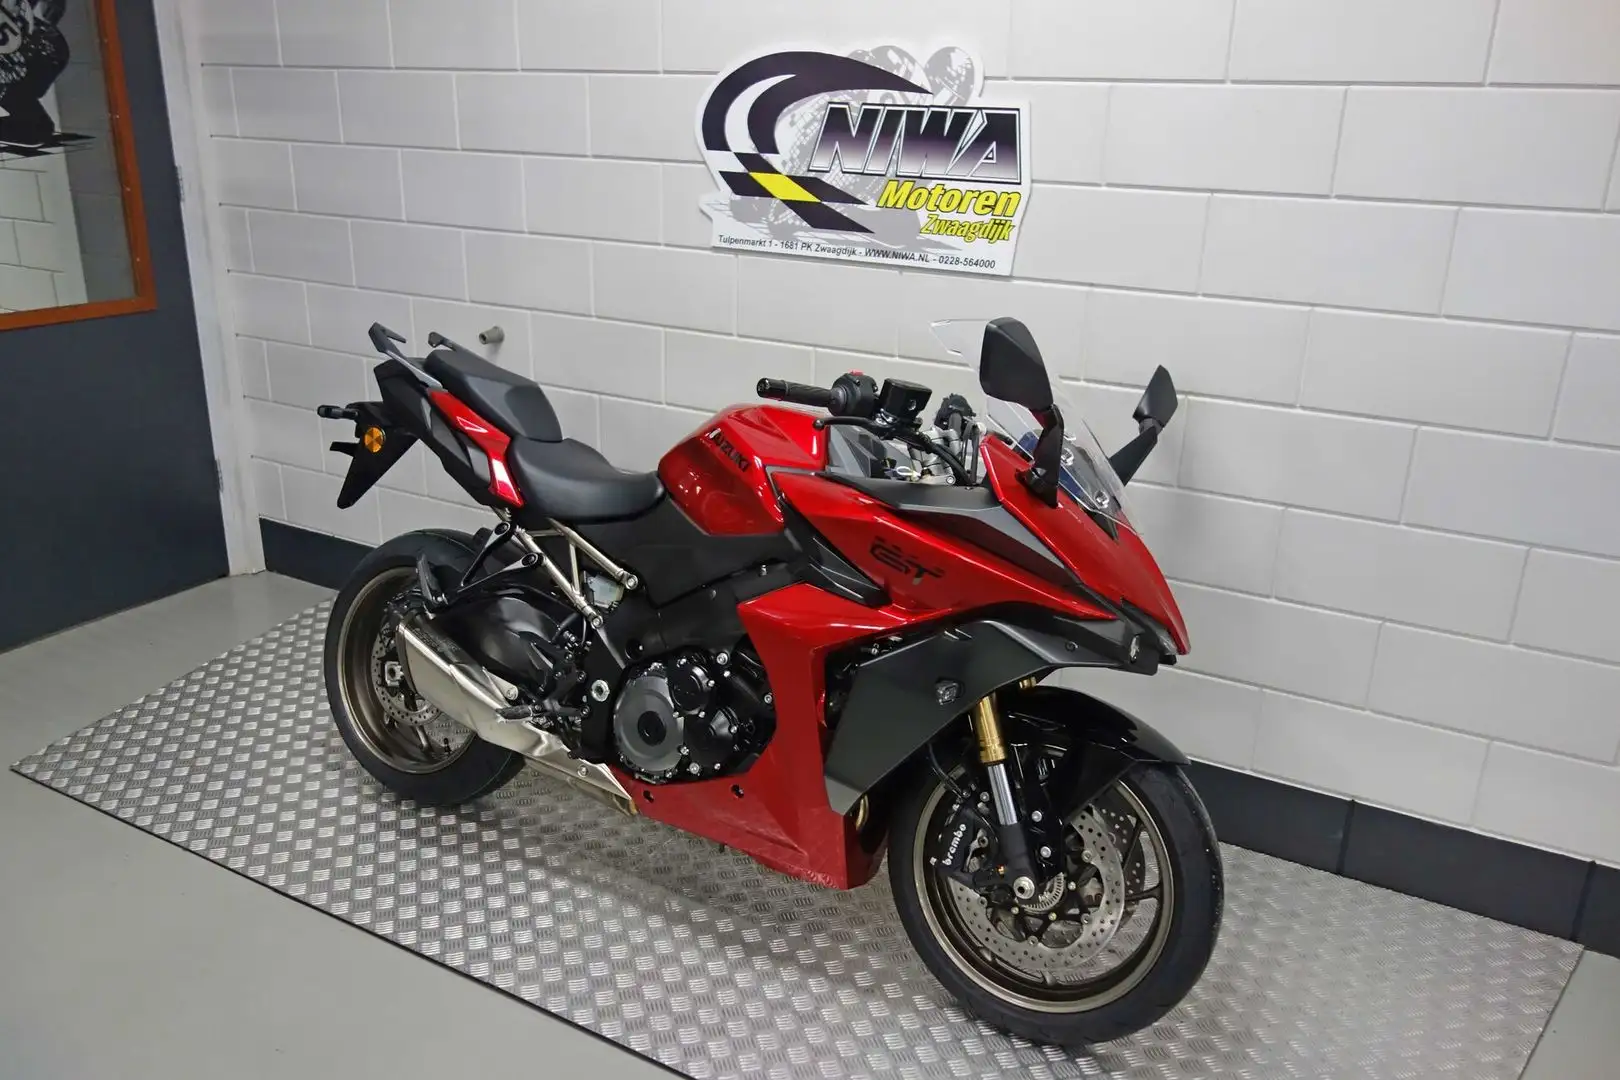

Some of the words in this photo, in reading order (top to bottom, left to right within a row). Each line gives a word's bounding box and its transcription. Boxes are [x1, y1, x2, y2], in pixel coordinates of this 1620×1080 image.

[808, 102, 1021, 185] NIWA
[876, 179, 1022, 218] Motoren
[919, 213, 1015, 244] Zwaagdijk
[718, 234, 767, 249] Tulpenmarkt
[768, 239, 773, 248] 1
[780, 240, 799, 251] 1681
[800, 242, 813, 252] PK
[814, 243, 858, 257] Zwaagdijk
[864, 248, 931, 263] WWW.NIWA.NL
[938, 255, 996, 269] 0228-564000
[708, 428, 750, 472] UZUKI
[869, 535, 946, 586] GT
[941, 823, 967, 866] brembo
